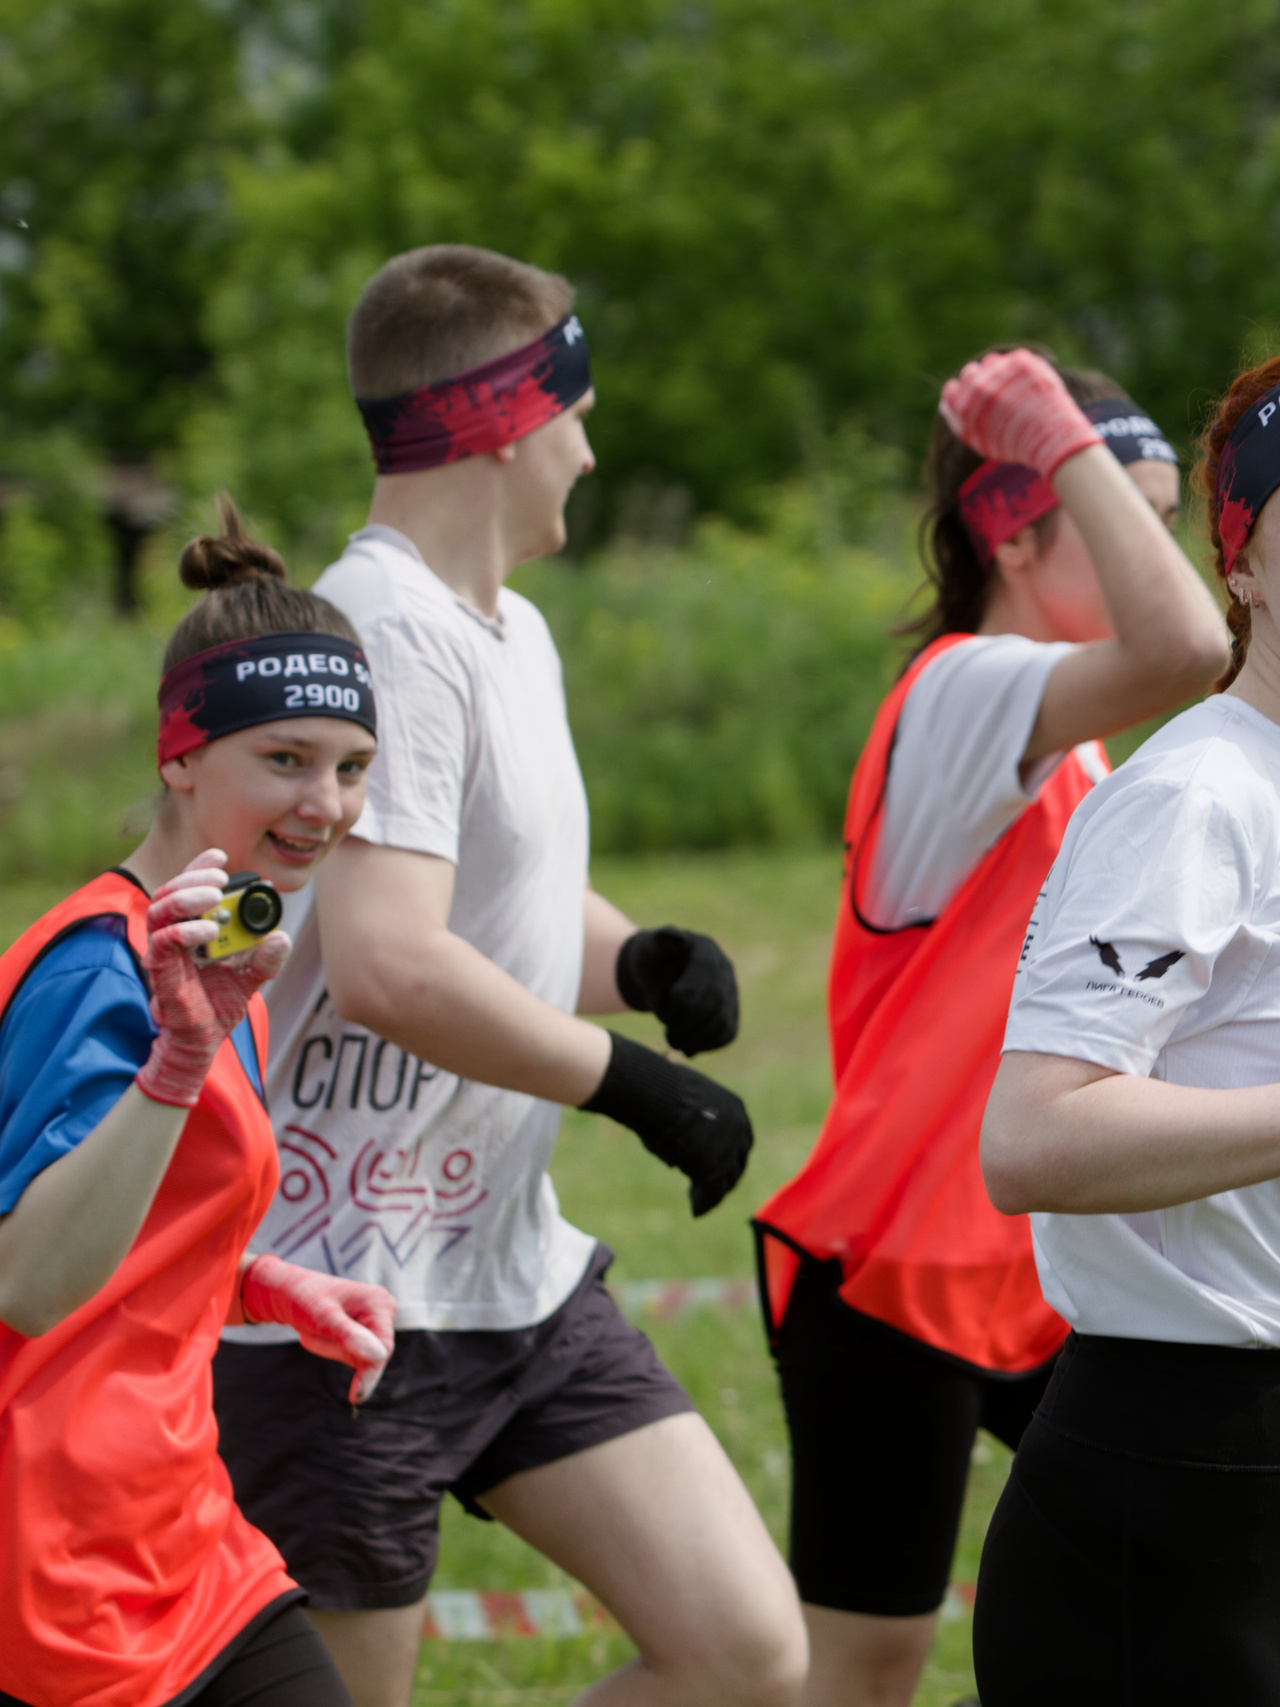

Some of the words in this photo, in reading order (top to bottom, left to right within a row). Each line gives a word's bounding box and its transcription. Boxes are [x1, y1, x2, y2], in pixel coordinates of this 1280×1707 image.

[236, 653, 350, 682] РОДЕО
[284, 683, 360, 712] 2900
[291, 1033, 462, 1112] СПОР
